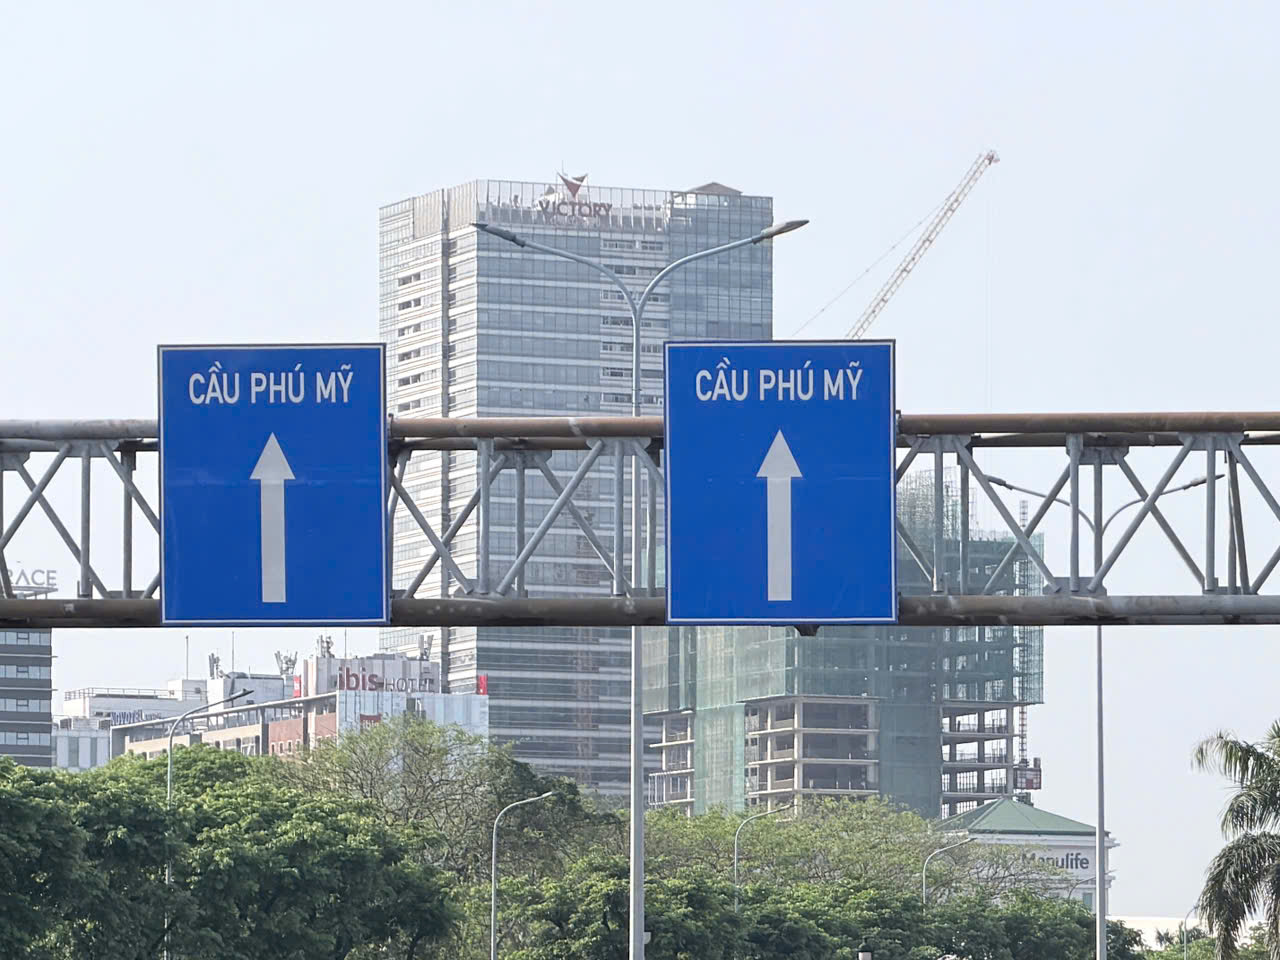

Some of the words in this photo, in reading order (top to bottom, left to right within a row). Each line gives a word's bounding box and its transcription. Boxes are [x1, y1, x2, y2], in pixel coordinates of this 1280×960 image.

[538, 200, 613, 219] VICTORY
[188, 361, 240, 404] CẦU
[250, 363, 305, 404] PHÚ
[316, 364, 354, 404] MỸ
[695, 357, 749, 401] CẦU
[759, 360, 814, 401] PHÚ
[823, 360, 863, 401] MỸ
[338, 667, 379, 691] ibis
[384, 678, 434, 693] HOTEL
